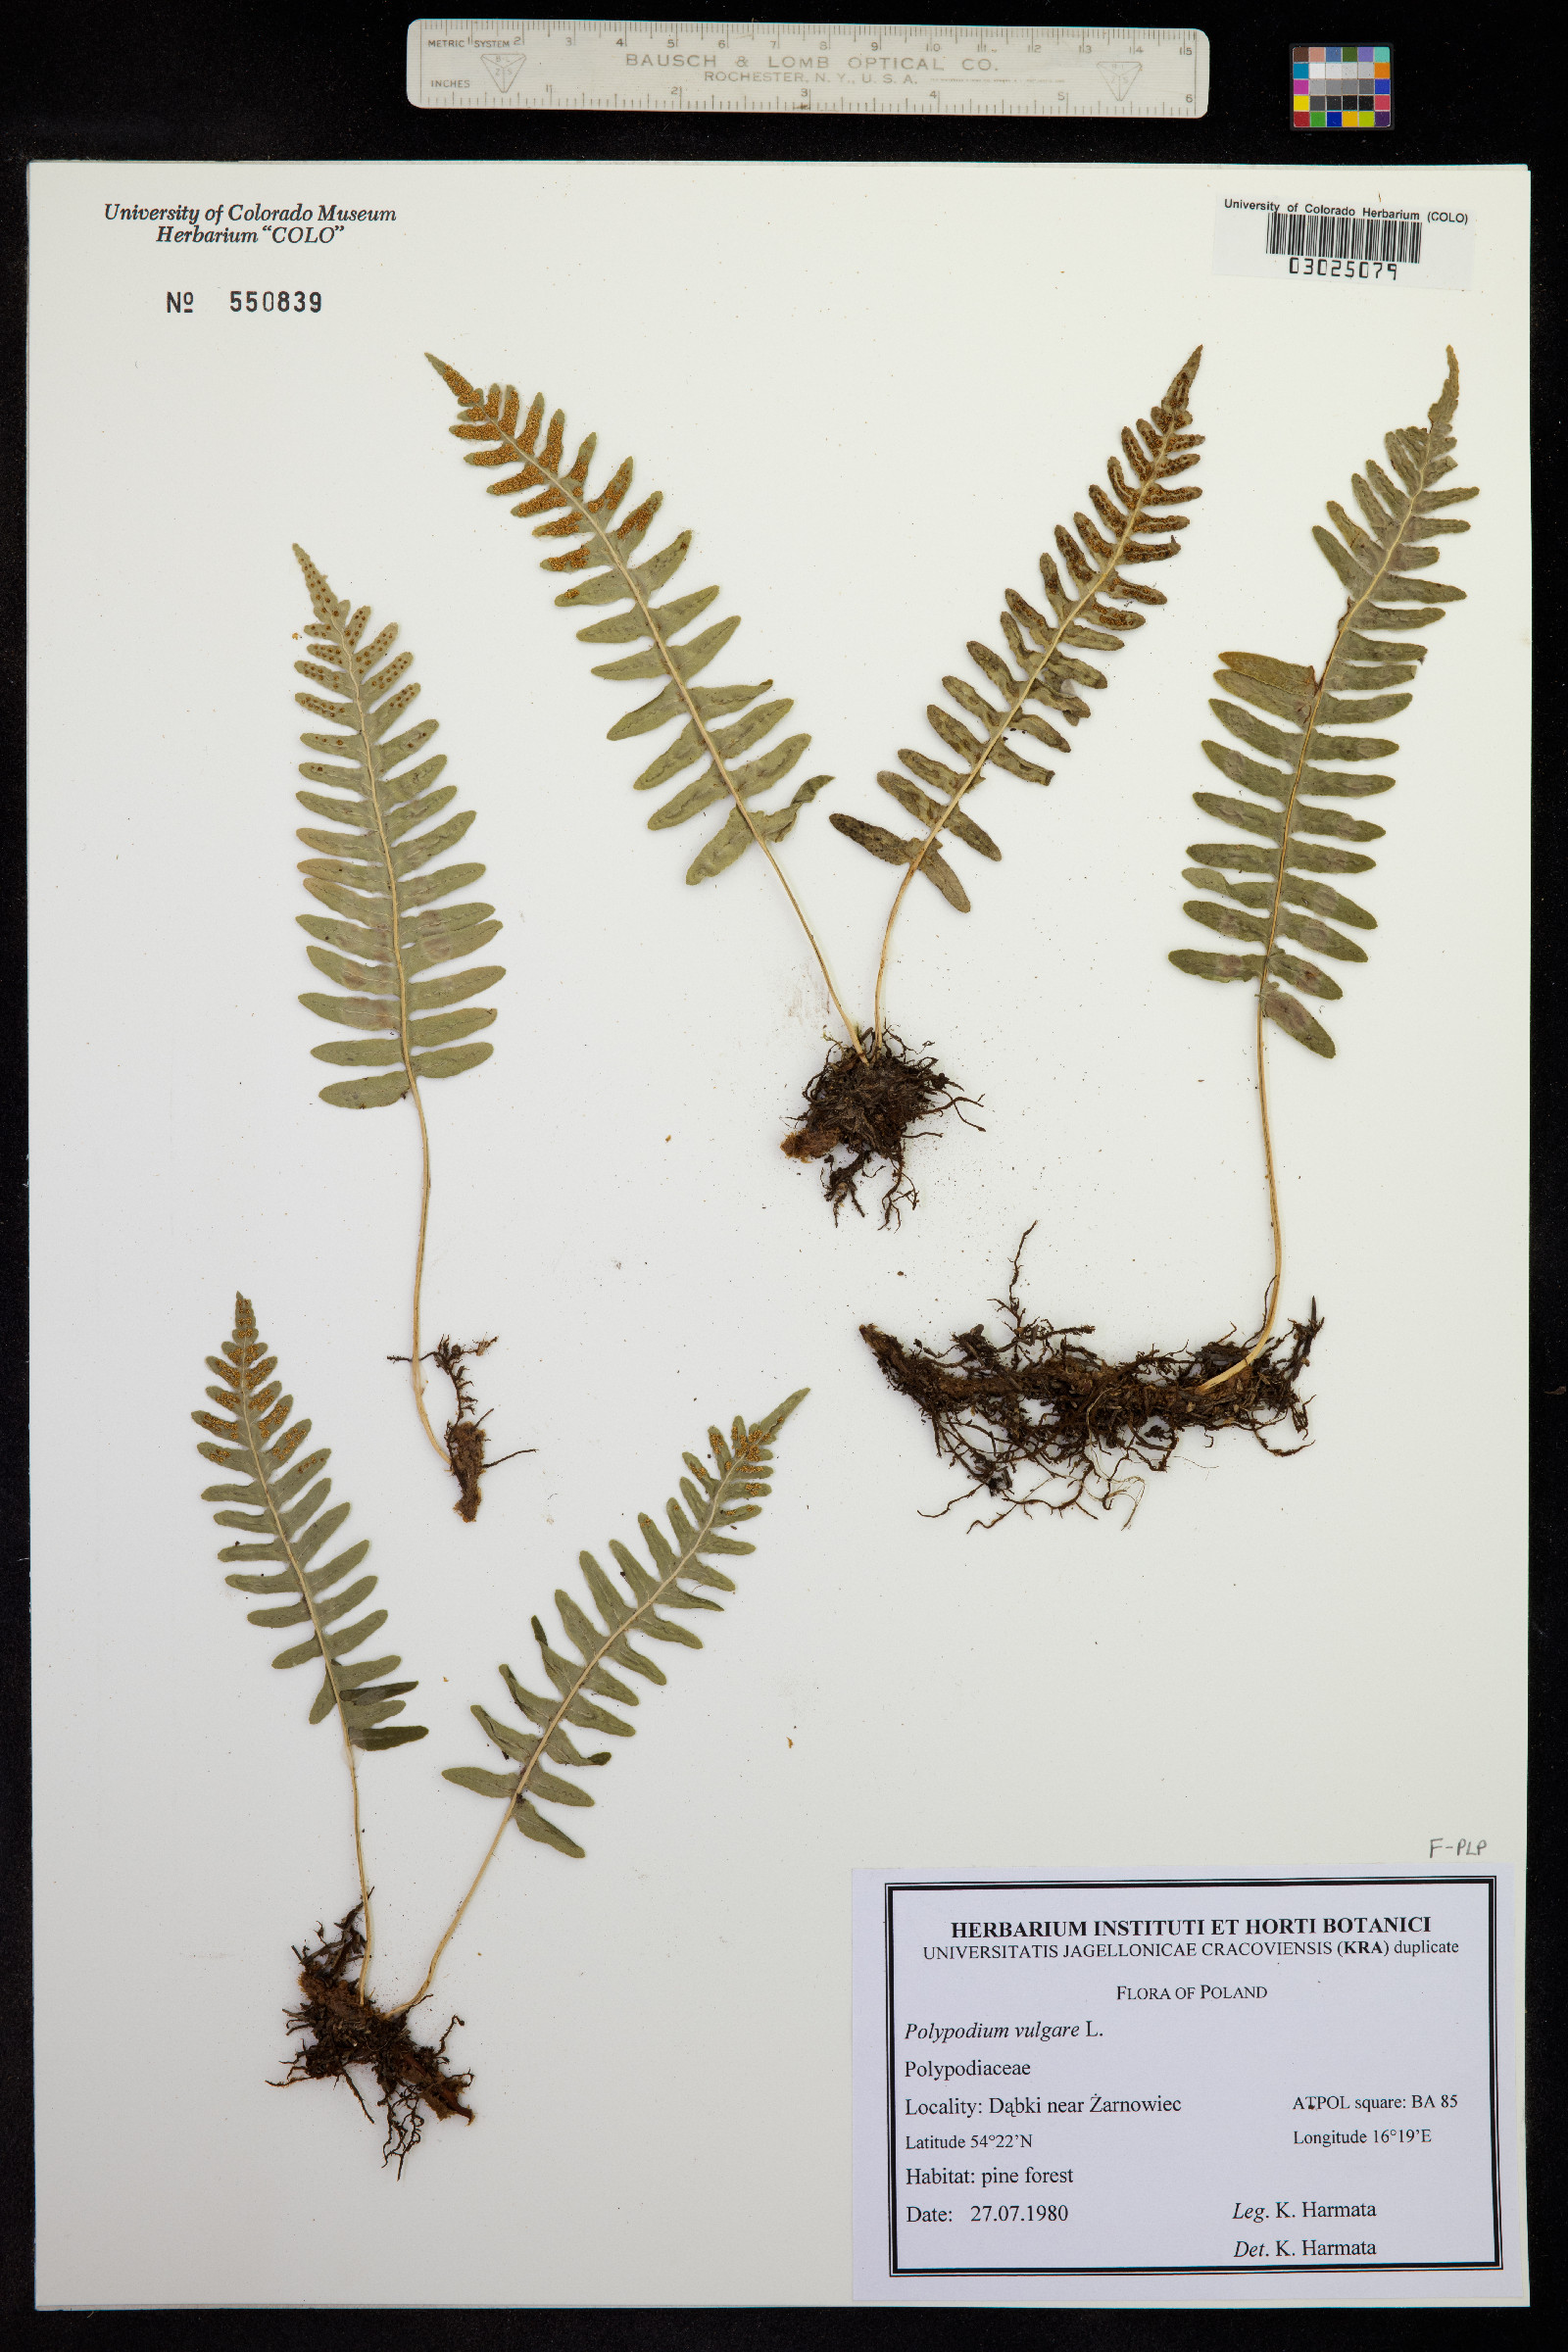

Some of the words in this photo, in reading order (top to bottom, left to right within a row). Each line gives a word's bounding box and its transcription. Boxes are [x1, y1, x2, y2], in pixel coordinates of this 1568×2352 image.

[565, 37, 571, 46] 3
[820, 41, 827, 50] 8
[871, 42, 878, 51] 9
[626, 54, 715, 67] BAUSCH
[736, 57, 748, 68] &
[768, 57, 828, 69] LOMB
[848, 58, 944, 71] OPTICAL
[962, 59, 999, 71] CO.
[705, 72, 808, 82] ROCHESTER,
[801, 88, 808, 97] 3
[1058, 92, 1064, 101] 5
[1186, 94, 1193, 103] 6
[105, 204, 200, 224] University
[205, 205, 223, 225] of
[228, 203, 313, 220] Colorado
[318, 205, 396, 221] Museum
[1225, 199, 1280, 212] University
[1305, 204, 1355, 216] Colorado
[1362, 208, 1419, 220] Herbarium
[1427, 212, 1468, 225] (COLO)
[156, 224, 258, 243] Herbarium
[1290, 257, 1397, 280] 03025079
[230, 291, 321, 313] 550839
[951, 1922, 1087, 1937] HERBARIUM
[1094, 1920, 1204, 1936] INSTITUTI
[1211, 1920, 1239, 1935] ET
[1246, 1919, 1316, 1935] HORTI
[1324, 1917, 1431, 1933] BOTANICI
[923, 1945, 1057, 1959] UNIVERSITATIS
[1063, 1943, 1197, 1957] JAGELLONICAE
[1202, 1941, 1332, 1956] CRACOVIENSIS
[1338, 1940, 1389, 1957] (KRA)
[1395, 1940, 1458, 1957] duplicate
[1117, 1986, 1171, 1999] FLORA
[1175, 1987, 1196, 1999] OF
[1200, 1984, 1267, 1999] POLAND
[906, 2023, 1008, 2043] Polypodium
[1015, 2021, 1079, 2041] vulgare
[1086, 2021, 1102, 2036] L.
[906, 2060, 1030, 2081] Polypodiaceae
[906, 2098, 982, 2118] Locality:
[989, 2097, 1041, 2117] Dąbki
[1048, 2102, 1084, 2113] near
[1090, 2093, 1181, 2112] Żarnowiec
[1293, 2096, 1349, 2110] ATPOL
[1355, 2099, 1405, 2112] square:
[1412, 2095, 1435, 2108] BA
[1442, 2094, 1457, 2108] 85
[906, 2135, 965, 2149] Latitude
[1295, 2130, 1367, 2147] Longitude
[906, 2168, 974, 2184] Habitat:
[982, 2167, 1018, 2187] pine
[1025, 2167, 1073, 2182] forest
[906, 2207, 952, 2222] Date:
[971, 2205, 1068, 2222] 27.07.1980
[1232, 2203, 1269, 2223] Leg.
[1276, 2202, 1296, 2218] K.
[1302, 2202, 1377, 2217] Harmata
[1234, 2241, 1269, 2257] Det.
[1276, 2240, 1295, 2256] K.
[1301, 2240, 1376, 2255] Harmata
